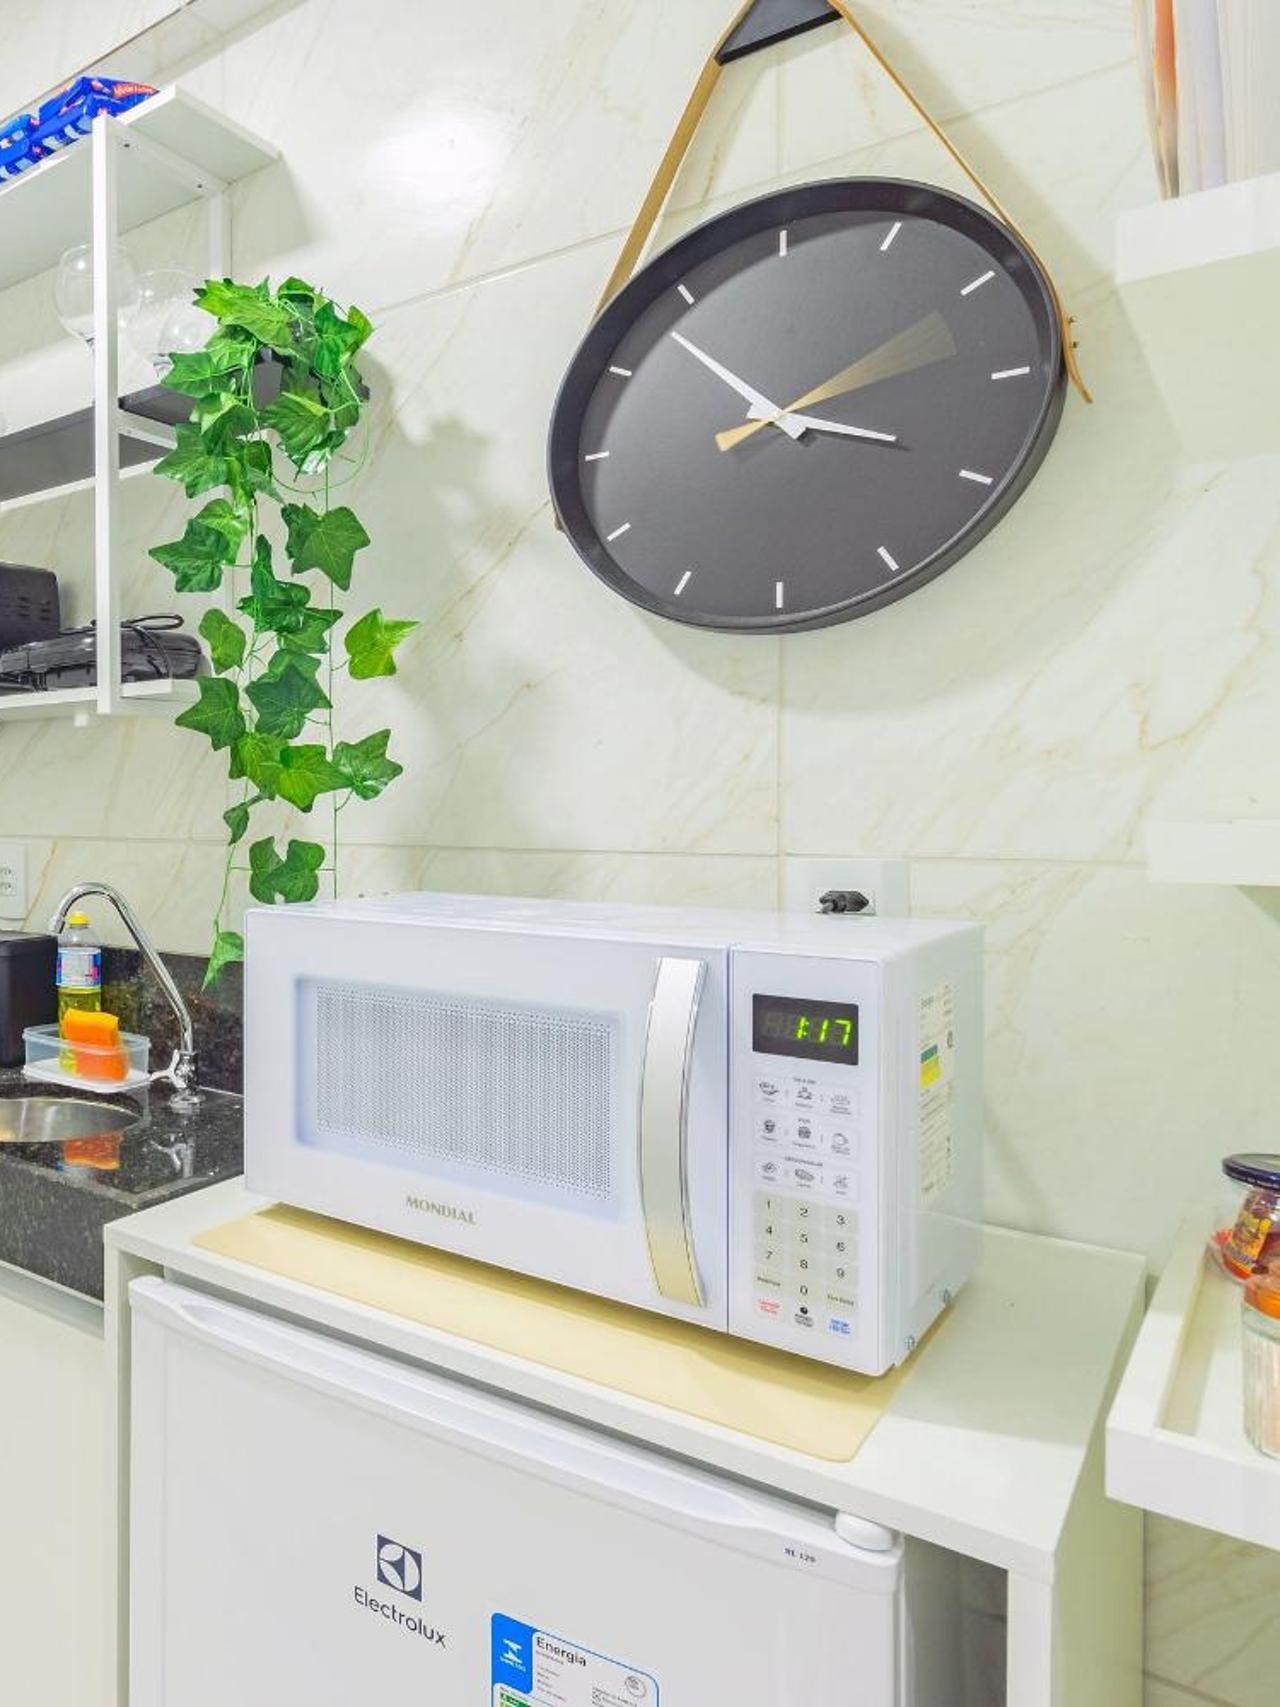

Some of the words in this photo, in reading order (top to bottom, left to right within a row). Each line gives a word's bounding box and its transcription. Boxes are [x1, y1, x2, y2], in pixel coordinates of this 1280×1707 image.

[796, 1016, 852, 1046] 1:17
[406, 1196, 477, 1225] MONDIAL
[799, 1207, 809, 1218] 2
[836, 1214, 846, 1226] 3
[765, 1226, 773, 1235] 4
[799, 1233, 809, 1244] 5
[836, 1241, 846, 1252] 6
[765, 1251, 773, 1260] 7
[799, 1259, 809, 1270] 8
[836, 1267, 845, 1279] 9
[799, 1285, 809, 1296] 0
[354, 1585, 446, 1648] Electrolux
[536, 1636, 586, 1667] Energia
